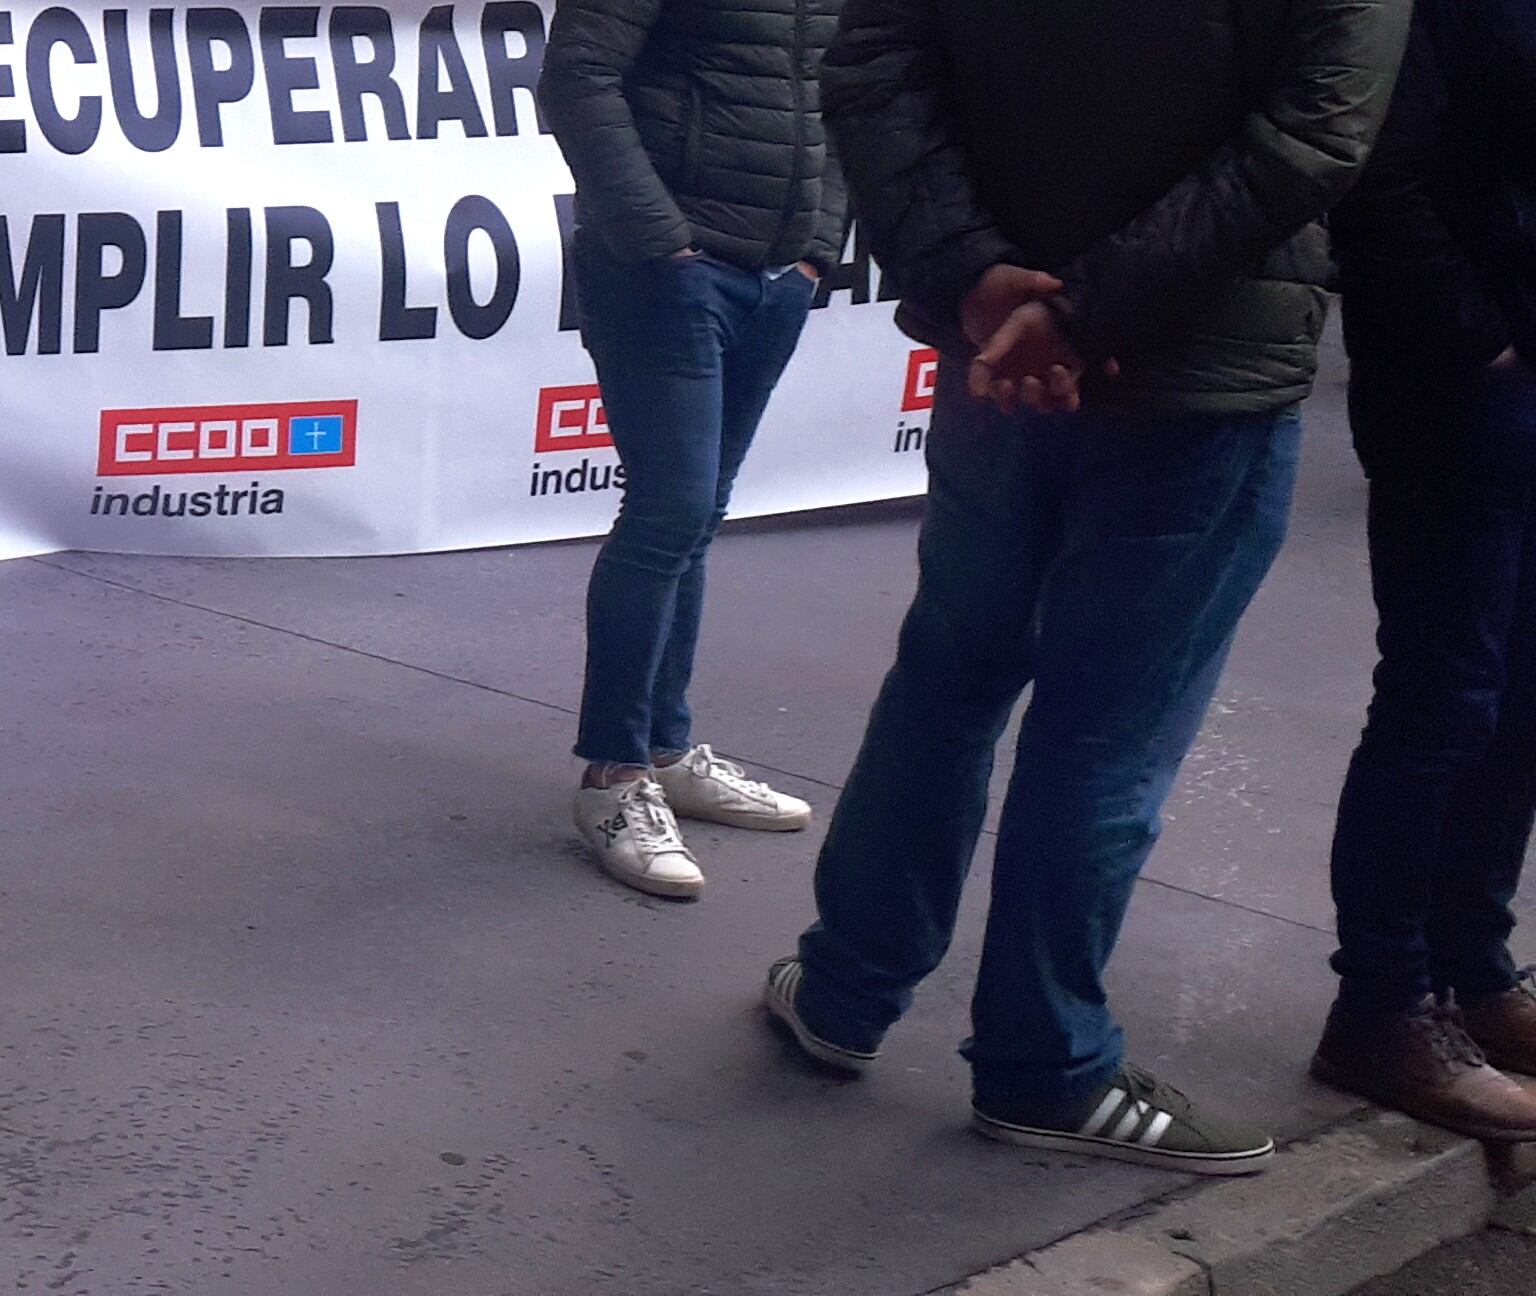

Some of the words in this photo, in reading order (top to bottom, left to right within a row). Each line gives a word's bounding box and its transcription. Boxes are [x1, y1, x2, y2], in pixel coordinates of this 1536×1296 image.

[374, 194, 521, 342] LO
[114, 418, 281, 465] CCOO
[529, 457, 628, 497] indus
[89, 482, 285, 519] industria
